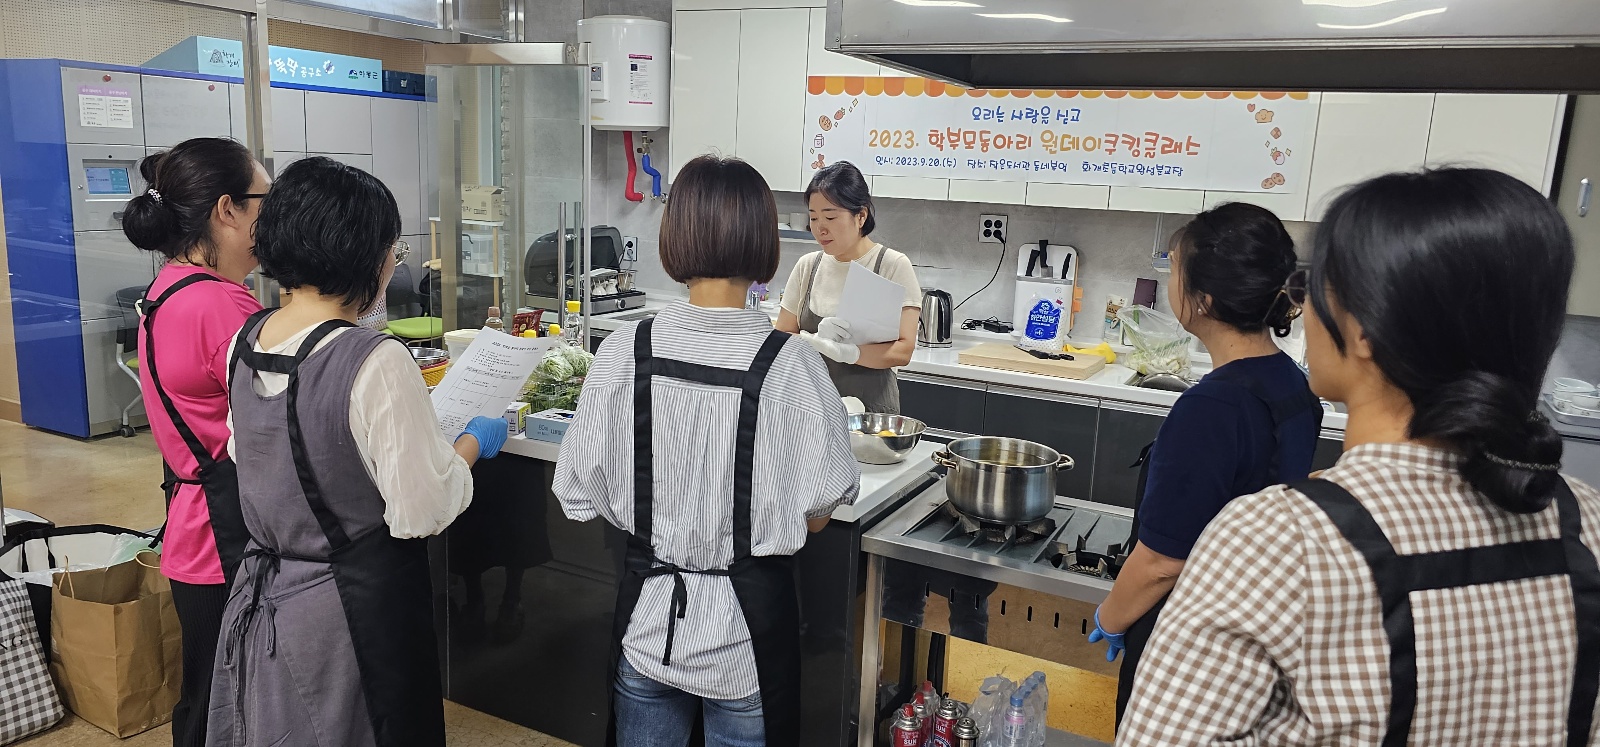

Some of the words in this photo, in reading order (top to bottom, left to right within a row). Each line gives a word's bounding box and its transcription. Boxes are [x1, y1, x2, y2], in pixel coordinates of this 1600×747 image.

[301, 66, 322, 78] 공구소
[972, 105, 1005, 123] 요리는
[1010, 105, 1051, 124] 사랑을
[1056, 108, 1081, 125] 싣고
[868, 129, 919, 149] 2023.
[928, 127, 1032, 153] 학부모동아리
[875, 155, 893, 165] 일시:
[895, 156, 957, 168] 2023.9.20.(수)
[967, 159, 986, 169] 장소:
[989, 158, 1030, 171] 작은도서관
[1033, 160, 1068, 172] 동네부엌
